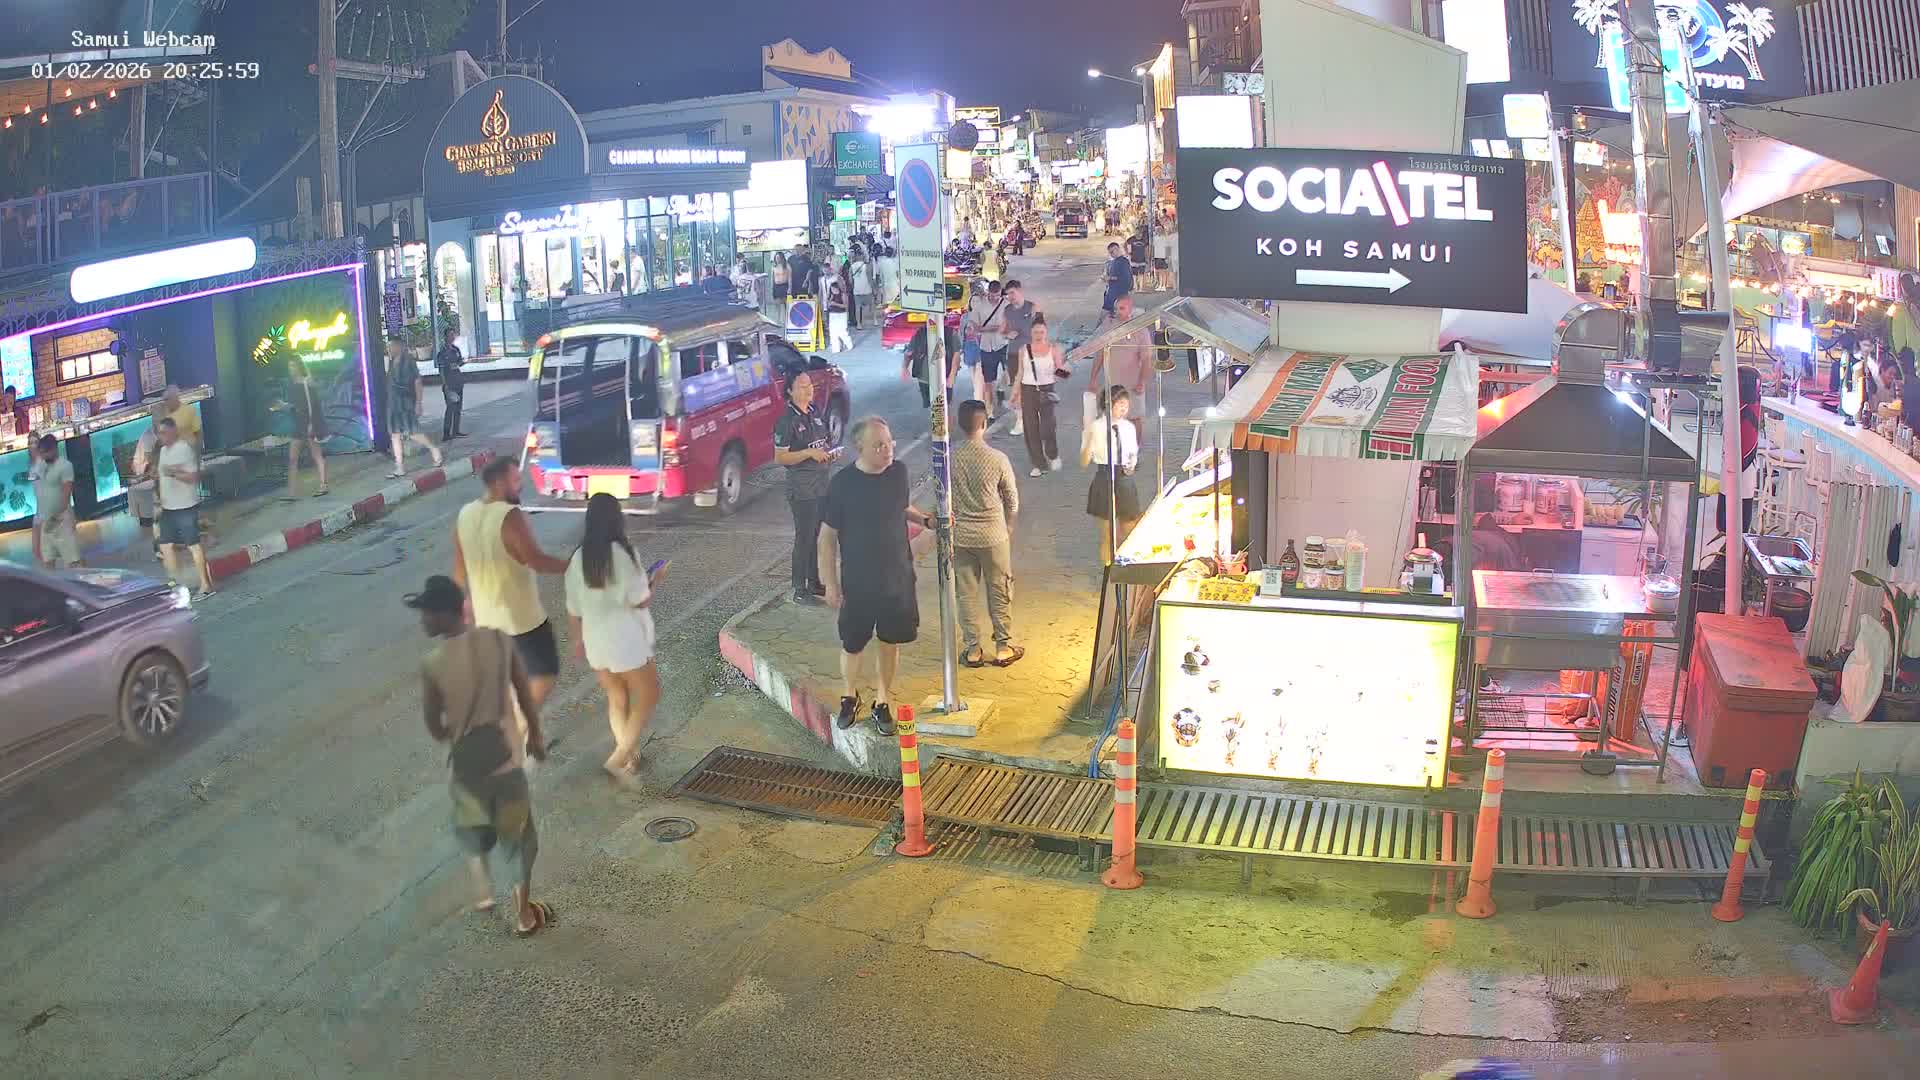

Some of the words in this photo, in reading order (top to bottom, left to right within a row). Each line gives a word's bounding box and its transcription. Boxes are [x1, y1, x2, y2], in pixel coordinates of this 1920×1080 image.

[838, 160, 879, 169] EXCHANGE
[1256, 238, 1323, 257] KOH
[1343, 240, 1451, 264] SAMUI
[905, 268, 913, 277] NO
[913, 269, 937, 279] PARKING
[1392, 355, 1442, 395] FOOD
[1368, 396, 1430, 456] INDIAN
